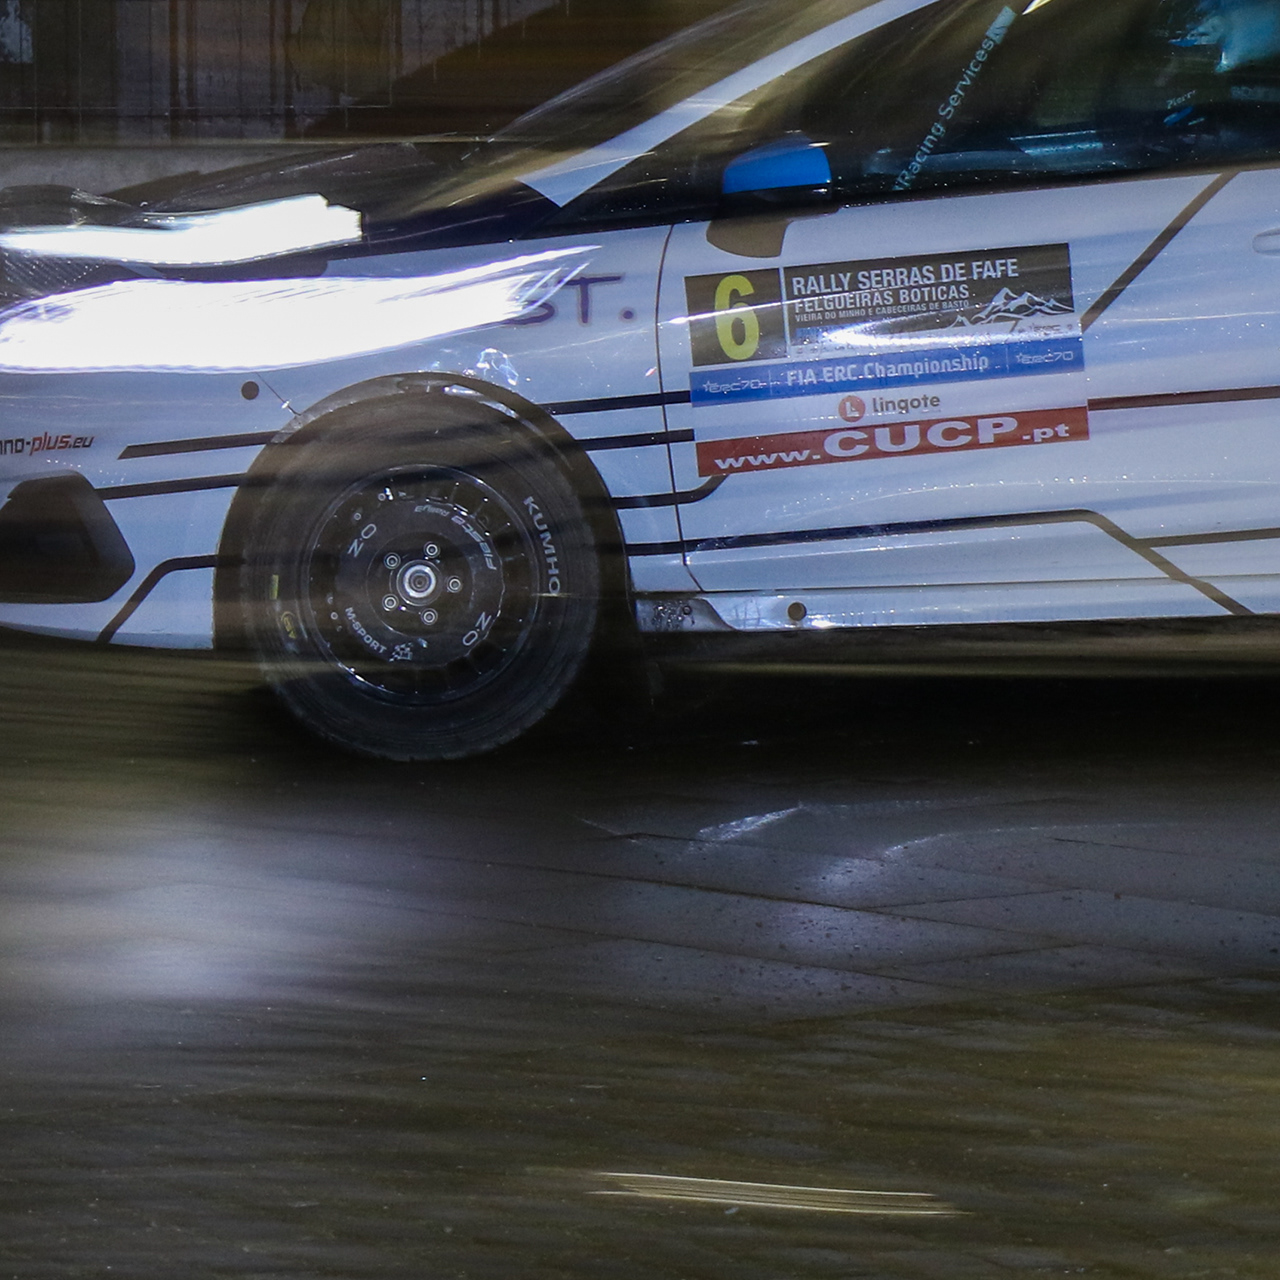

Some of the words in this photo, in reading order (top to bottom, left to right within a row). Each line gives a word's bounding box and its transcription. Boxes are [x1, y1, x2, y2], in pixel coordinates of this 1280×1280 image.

[897, 122, 946, 188] Racing
[938, 38, 995, 120] Services
[791, 272, 853, 296] RALLY
[858, 264, 935, 290] SERRAS
[941, 262, 967, 283] DE
[972, 258, 1019, 280] FAFE
[795, 290, 894, 313] FELGUEIRAS
[899, 284, 970, 304] BOTICAS
[714, 274, 760, 360] 6
[795, 311, 823, 322] VIEIRA
[825, 311, 837, 320] DO
[838, 308, 866, 318] MINHO
[875, 303, 929, 315] CABECEIRAS
[929, 302, 941, 311] DE
[941, 299, 970, 309] BASTO
[786, 369, 817, 387] FIA
[823, 364, 858, 384] ERC
[862, 353, 990, 381] Championship
[872, 393, 941, 418] lingote
[713, 416, 1071, 470] www.CUCP.pt
[524, 496, 562, 596] KUMHO
[344, 607, 388, 655] M-SPORT
